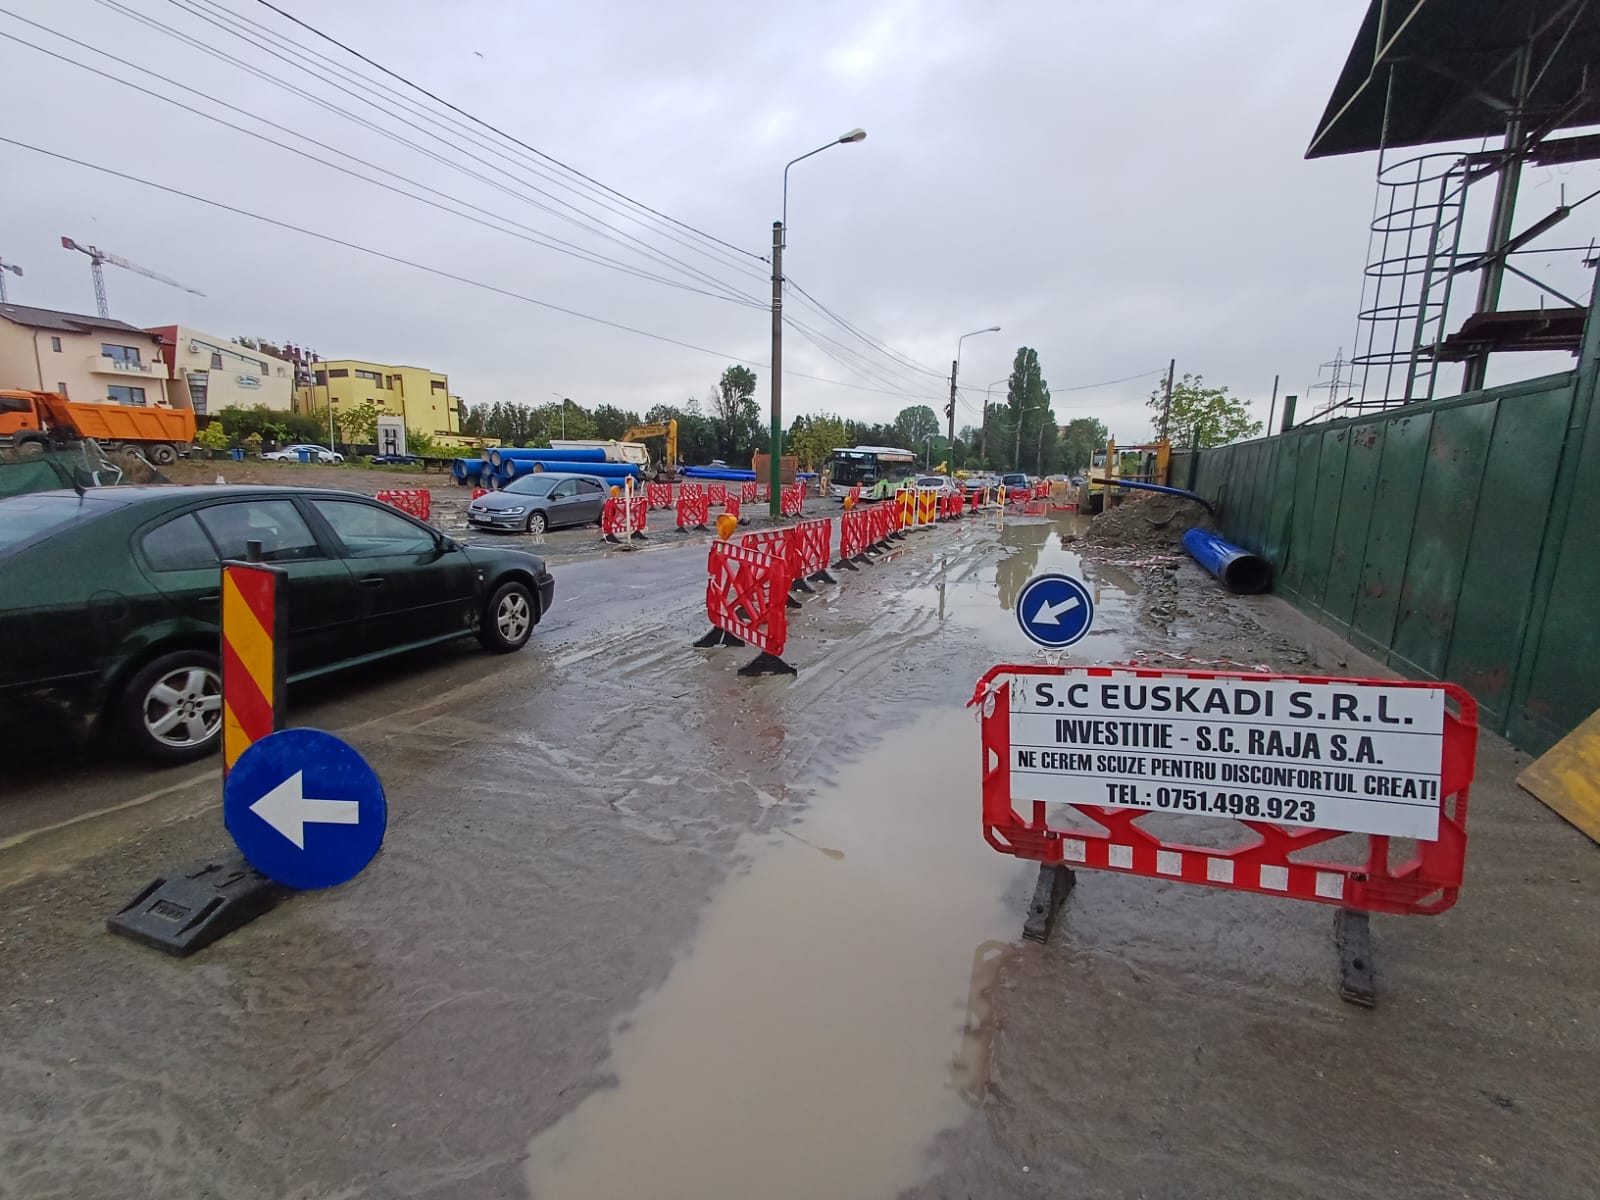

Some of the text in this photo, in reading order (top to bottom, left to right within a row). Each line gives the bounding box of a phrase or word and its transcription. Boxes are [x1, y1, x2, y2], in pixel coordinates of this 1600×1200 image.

[1035, 683, 1414, 725] S.C EUSKADI S.R.L.
[1055, 719, 1174, 749] INVESTITIE
[1196, 726, 1241, 754] S.C.
[1247, 729, 1322, 760] RAJA
[1329, 734, 1384, 765] S.A.
[1017, 750, 1438, 801] NE CEREM SCUZE PENTRU DISCONFORTUL CREAT!
[1105, 783, 1316, 823] TEL.: 0751.498.923
